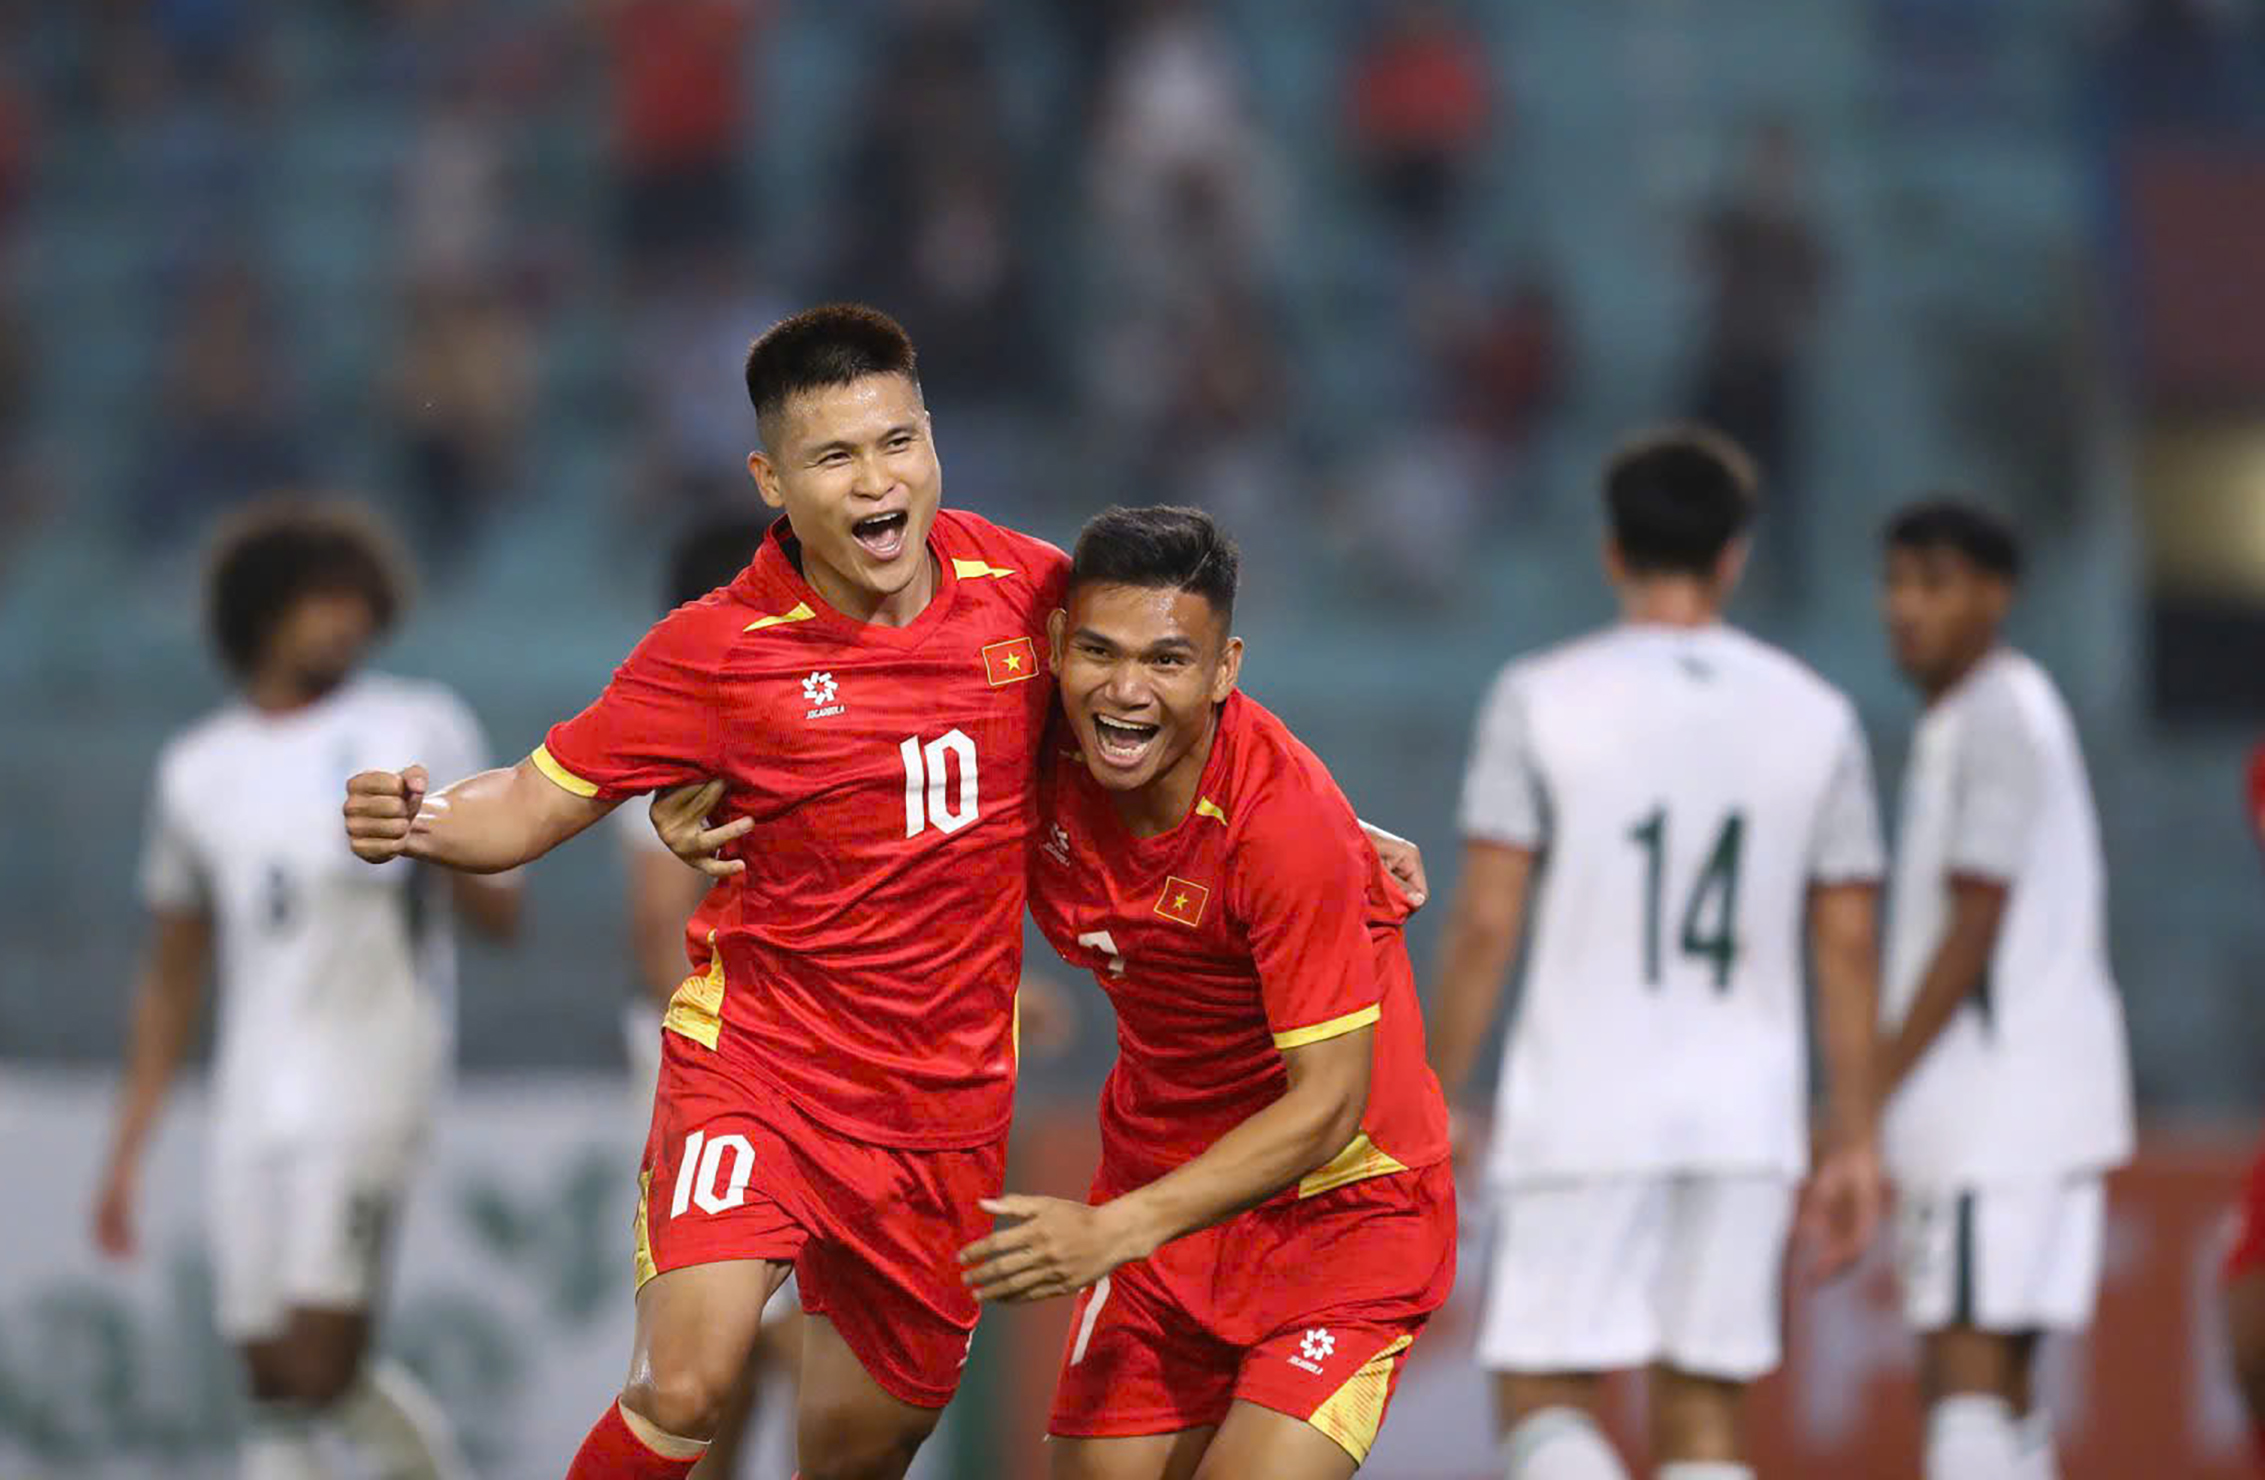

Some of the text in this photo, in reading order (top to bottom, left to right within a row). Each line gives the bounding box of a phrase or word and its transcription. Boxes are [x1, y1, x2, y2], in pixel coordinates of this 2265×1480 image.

[900, 728, 979, 838] 10
[1623, 803, 1745, 992] 14
[670, 1130, 756, 1219] 10
